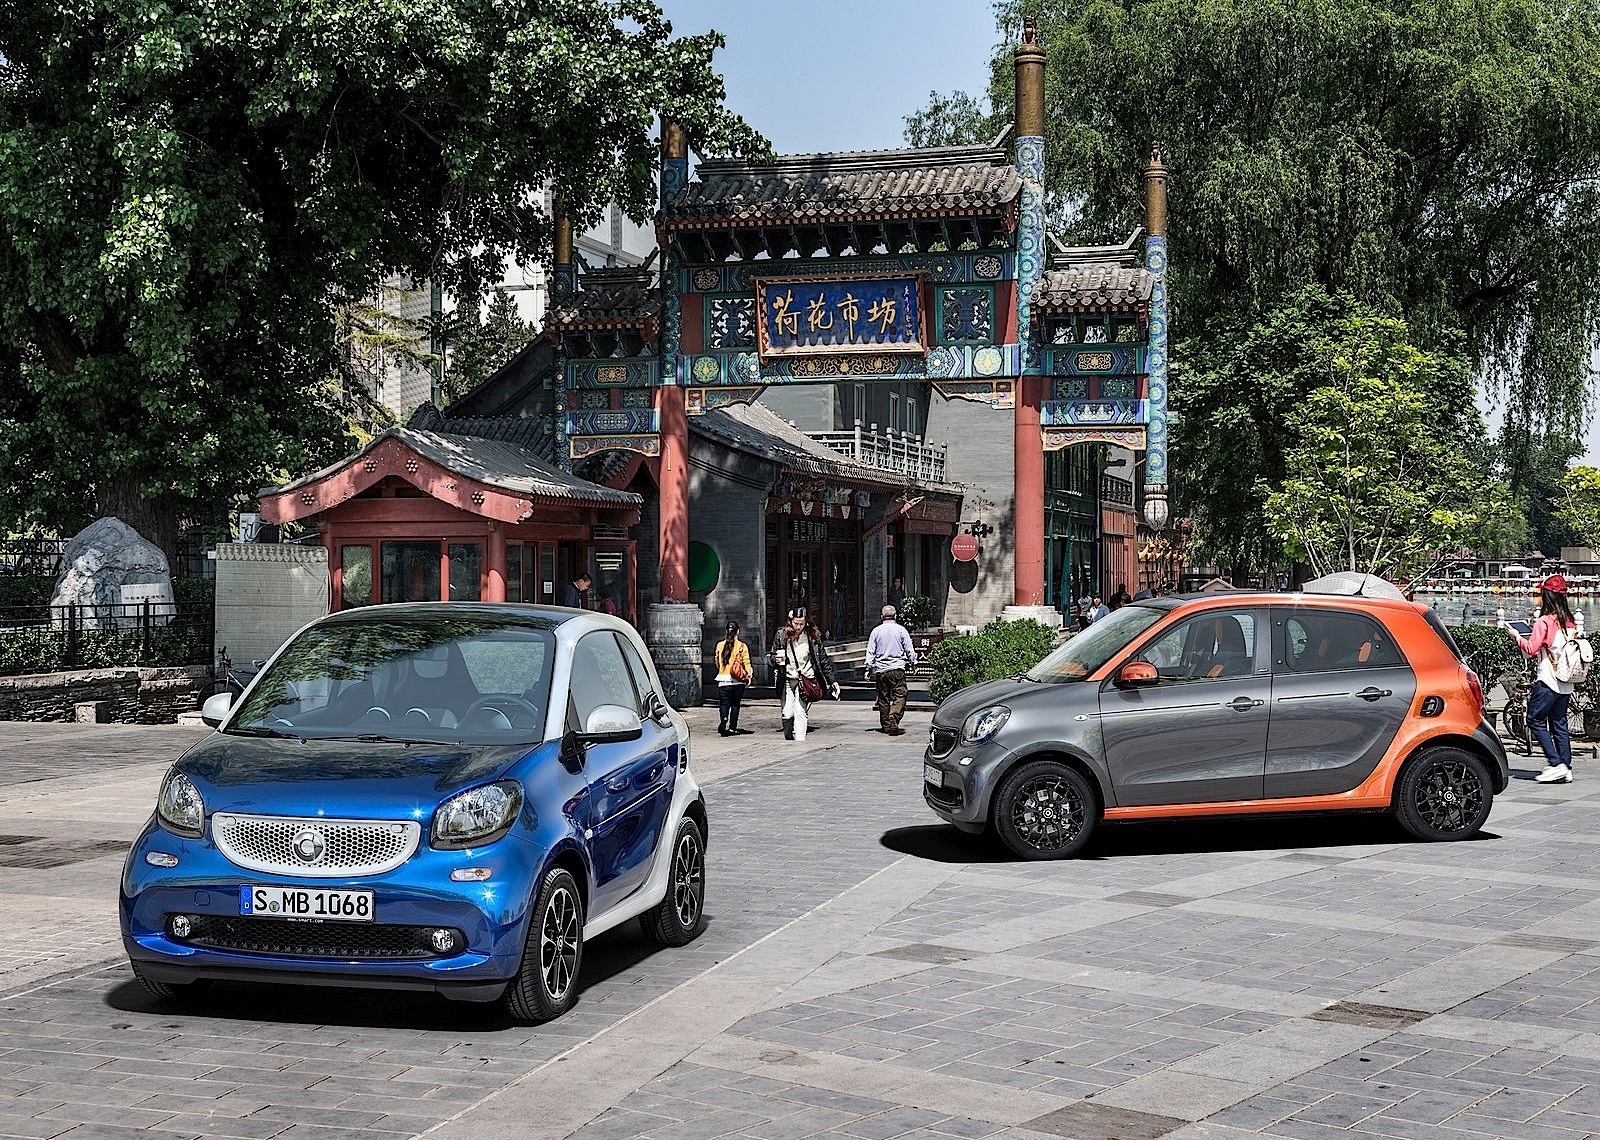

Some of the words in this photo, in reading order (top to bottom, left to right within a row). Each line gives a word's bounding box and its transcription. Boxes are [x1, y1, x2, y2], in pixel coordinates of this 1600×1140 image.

[254, 889, 268, 911] S
[282, 891, 310, 914] MB
[314, 893, 369, 917] 1068
